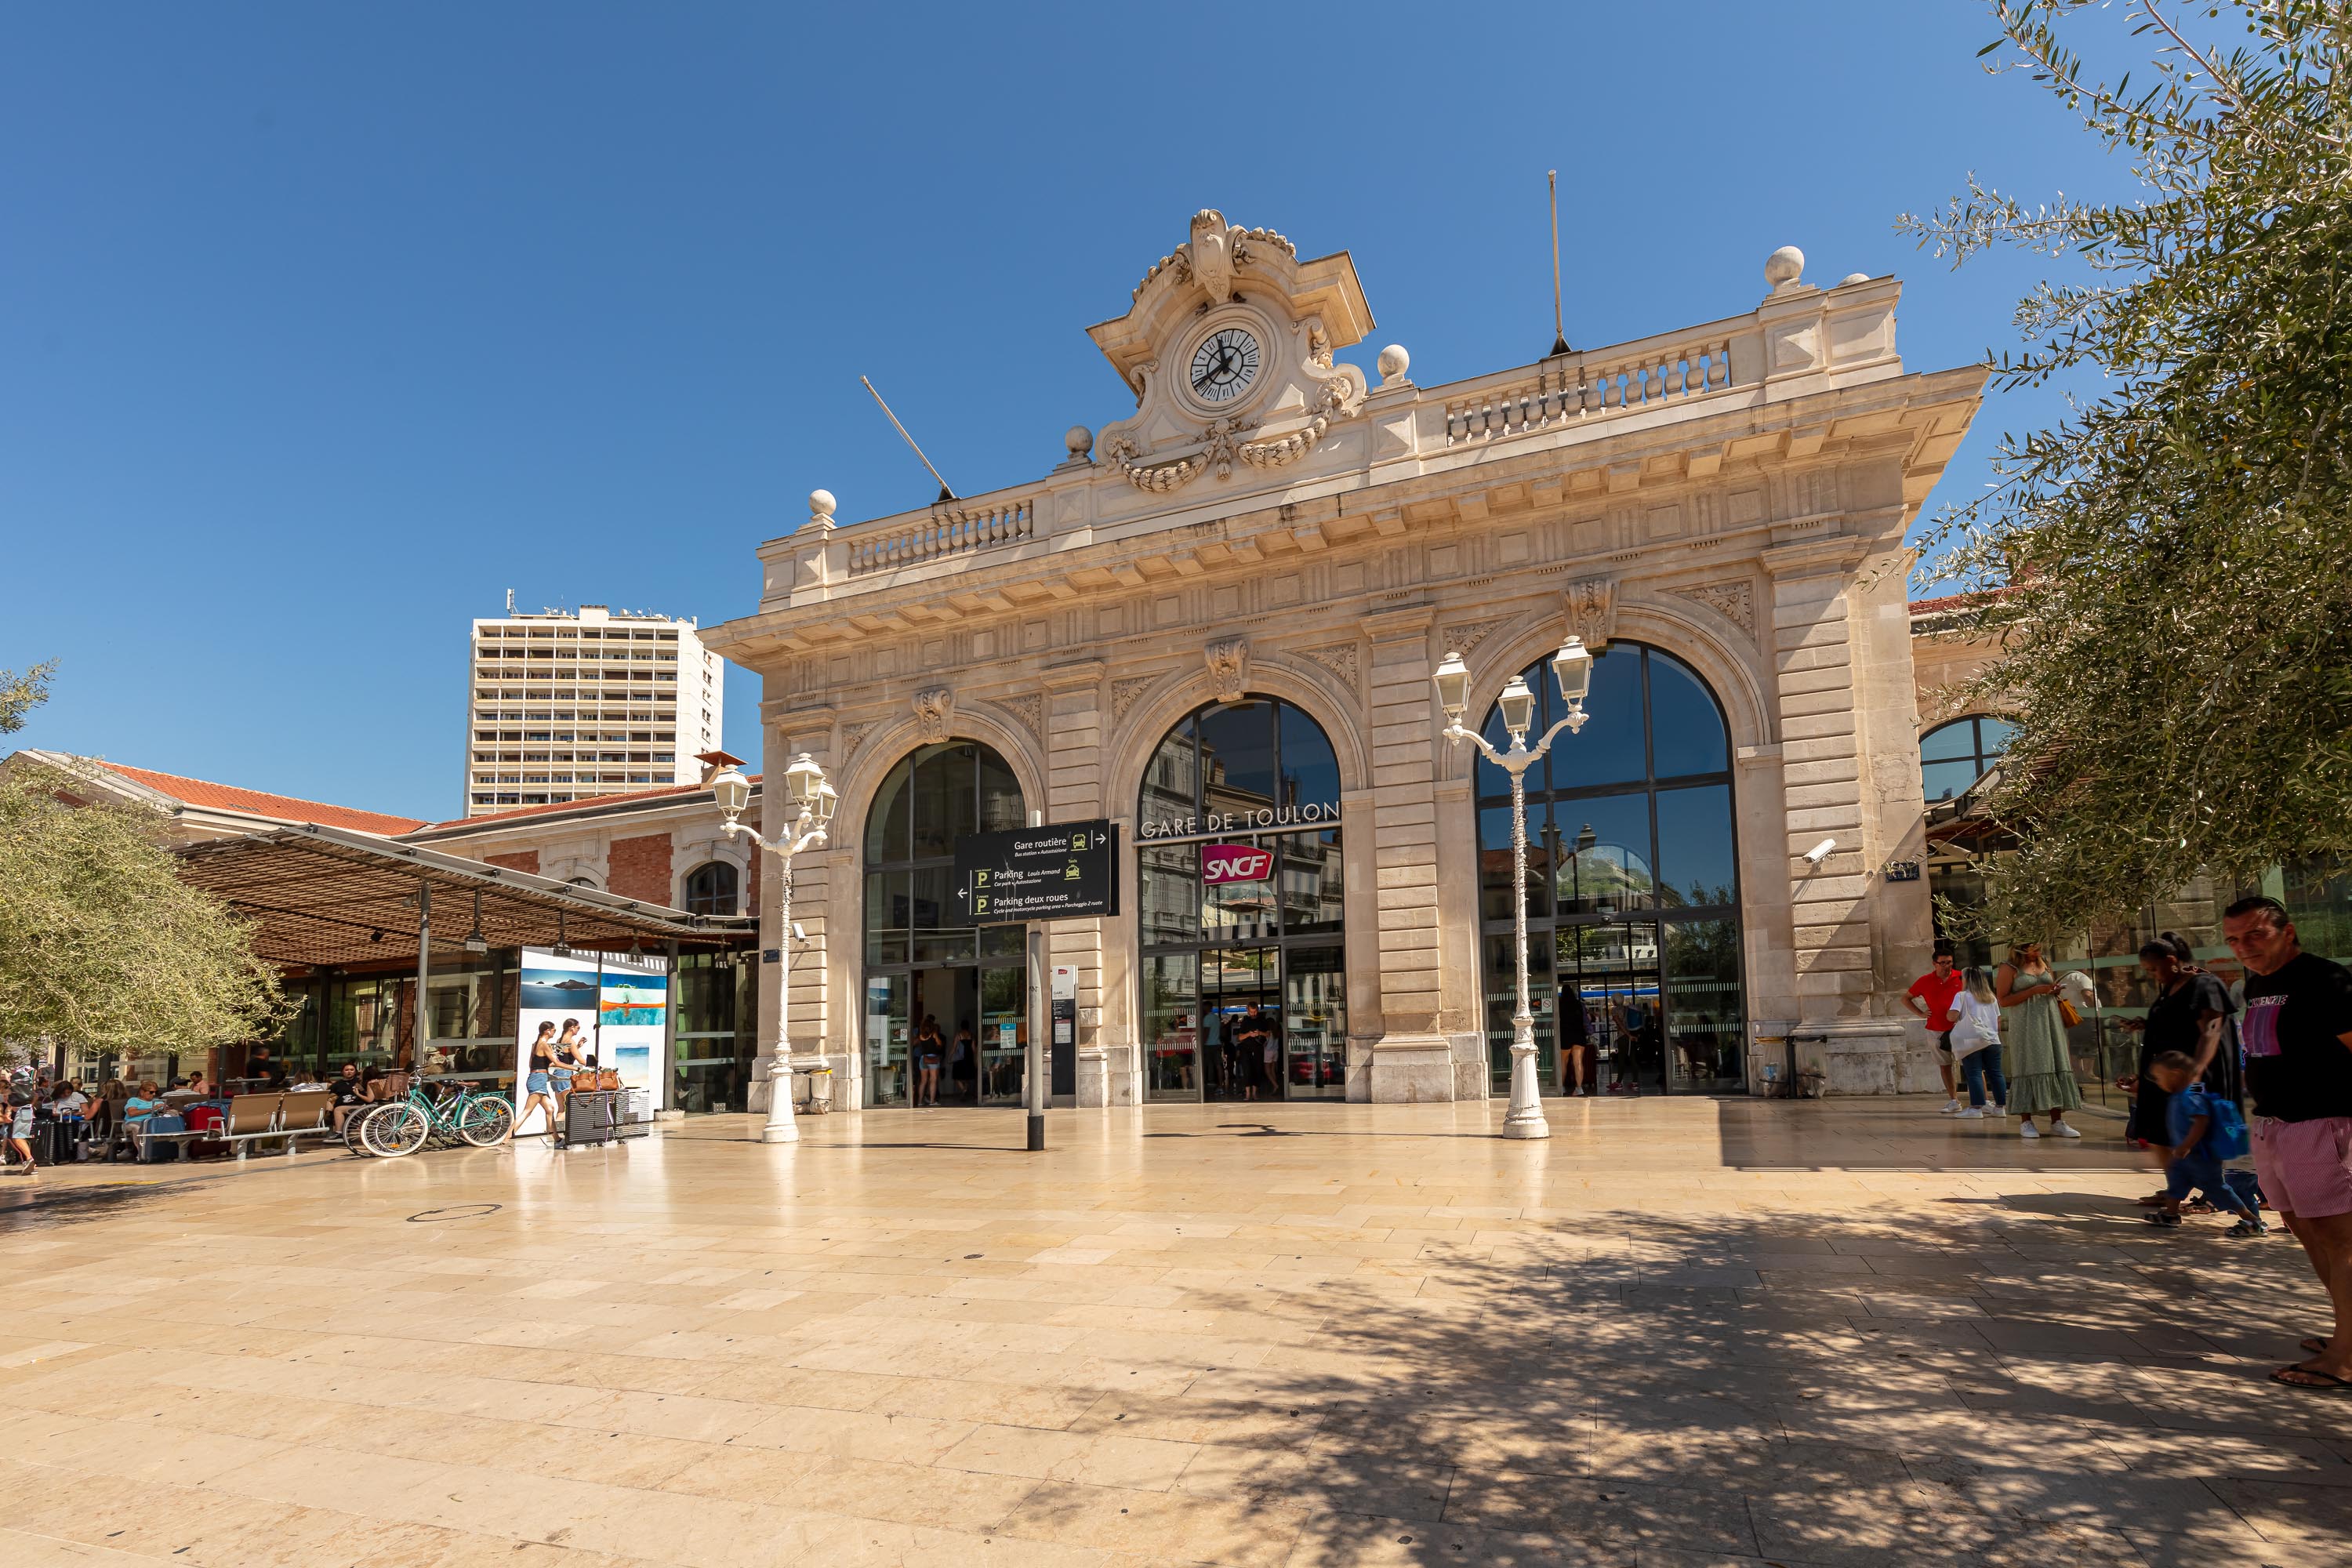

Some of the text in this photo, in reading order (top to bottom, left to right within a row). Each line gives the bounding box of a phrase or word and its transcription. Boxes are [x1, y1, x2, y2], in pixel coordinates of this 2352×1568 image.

[1142, 801, 1339, 837] GARE DE TOULON
[1035, 838, 1066, 848] routière
[1205, 855, 1266, 879] SNCF
[978, 873, 987, 885] P
[994, 870, 1023, 879] Parking
[978, 898, 986, 912] P
[994, 898, 1022, 906] Parking
